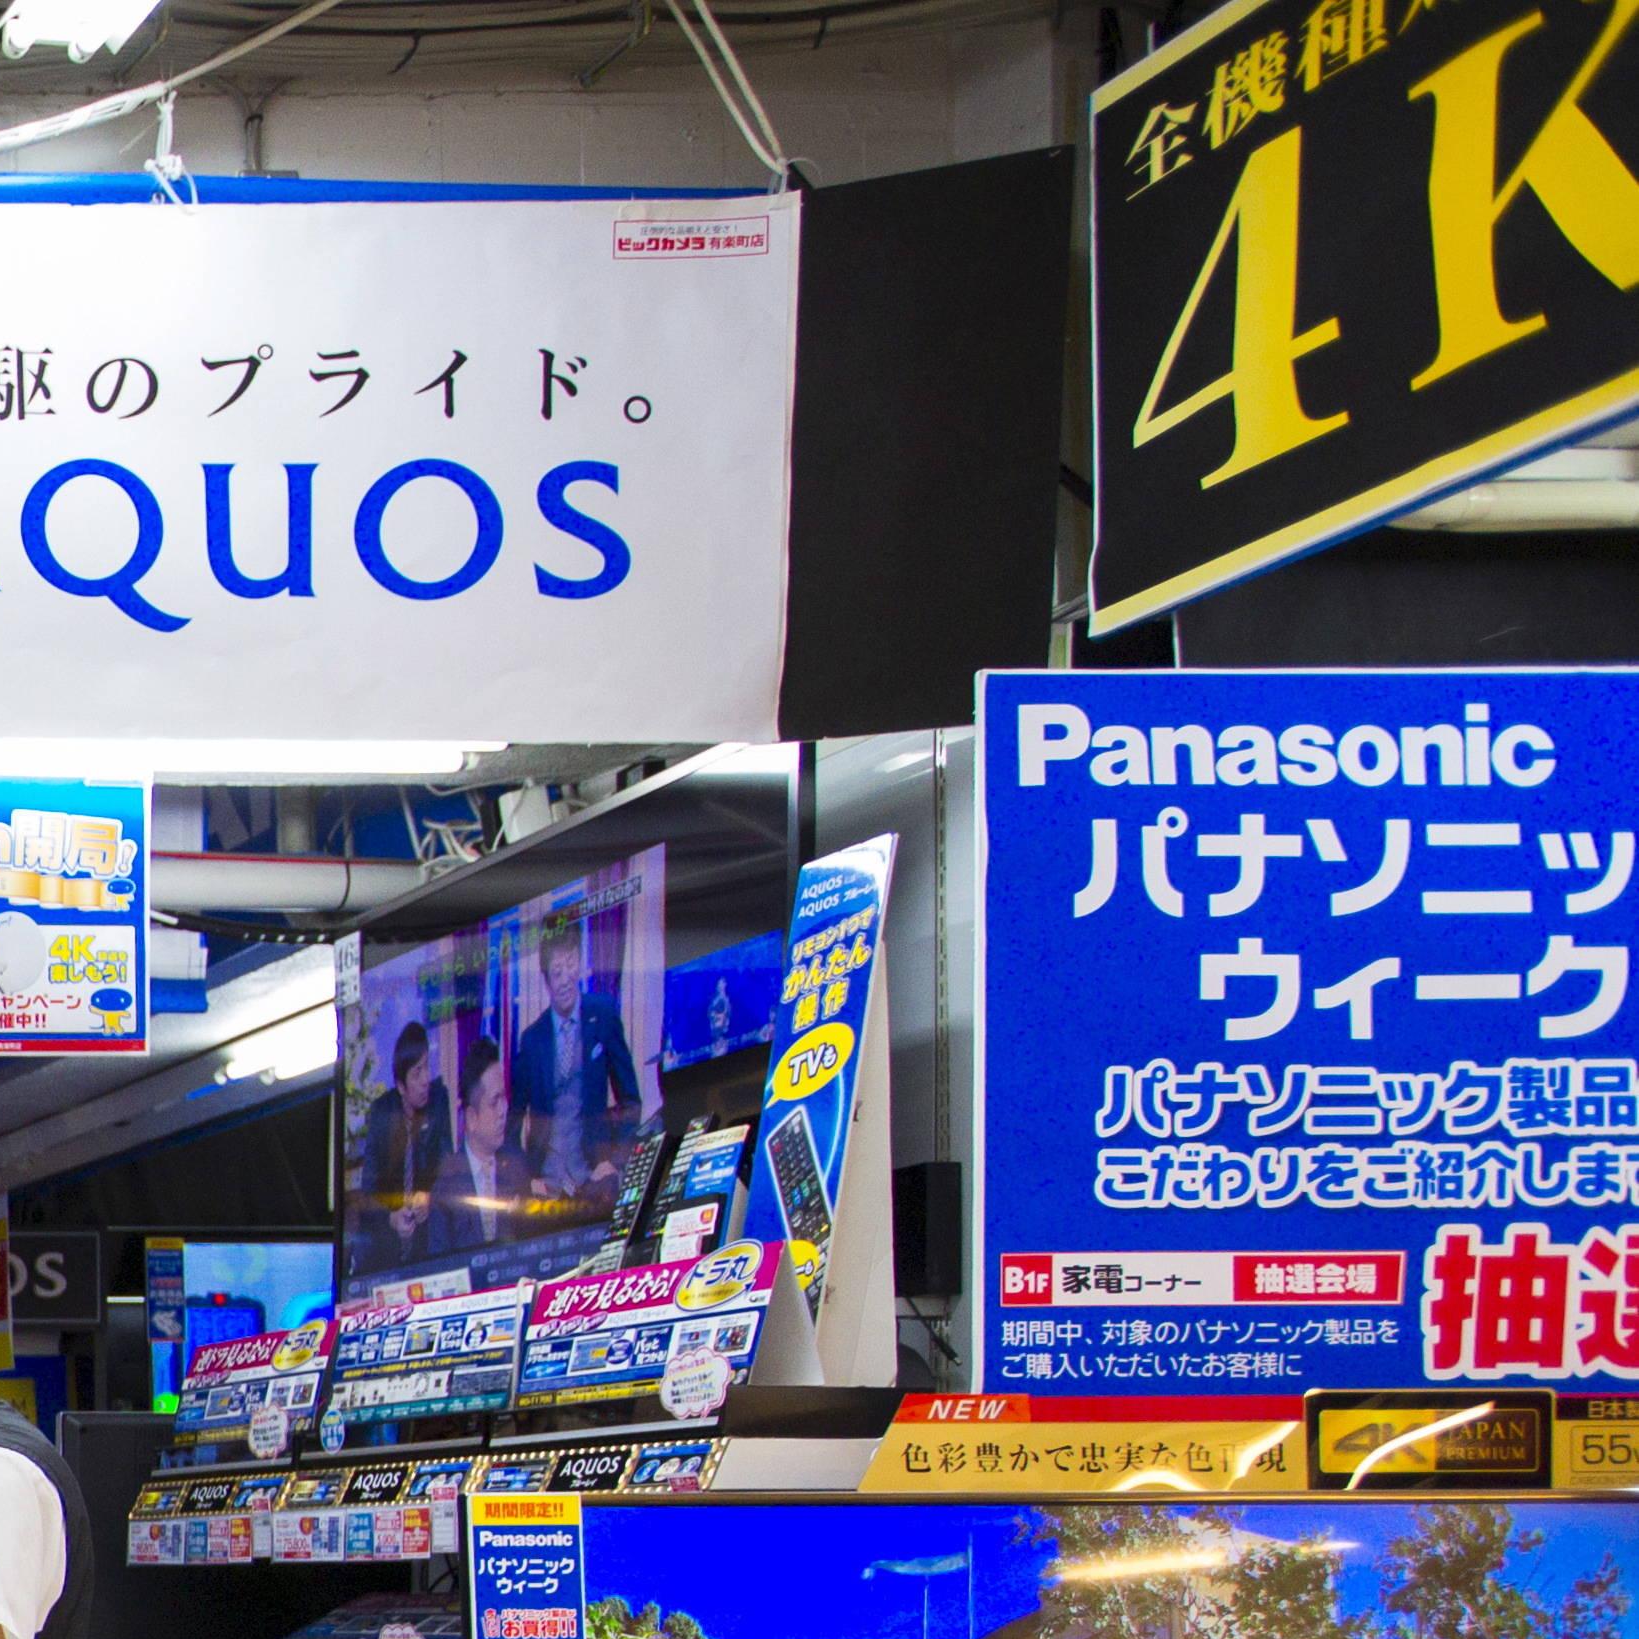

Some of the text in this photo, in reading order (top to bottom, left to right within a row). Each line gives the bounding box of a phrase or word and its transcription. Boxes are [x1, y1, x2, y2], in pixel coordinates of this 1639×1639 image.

[618, 234, 763, 251] ビックカメラ 有楽町店
[1133, 0, 1639, 489] 4K
[1017, 702, 1557, 787] Panasonic
[1073, 806, 1635, 919] パナソニッ
[801, 874, 843, 901] AQUOS
[797, 894, 839, 918] AQUOS
[48, 935, 94, 960] 4K
[783, 935, 870, 1002] かんたん
[1199, 934, 1629, 1042] ウィーク
[793, 984, 848, 1030] 操作
[788, 1044, 838, 1085] TVも
[1095, 1056, 1639, 1138] パナソニック製品
[543, 1265, 675, 1316] 連ドラ見るなら!
[1003, 1262, 1378, 1296] B1F 家電コーナー 抽選会場
[1001, 1319, 1400, 1349] 期間中、対象のパナソニック製品を
[1001, 1352, 1304, 1380] ご購入いただいたお客様に
[926, 1400, 1009, 1420] NEW
[353, 1471, 401, 1489] AQUOS
[557, 1456, 623, 1478] AQUOS
[190, 1485, 228, 1499] AQUOS
[485, 1502, 563, 1518] 期間限定!!
[479, 1531, 573, 1547] Panasonic
[478, 1558, 575, 1575] パナソニック
[496, 1578, 559, 1595] ウィーク
[502, 1619, 577, 1638] お買得!!
